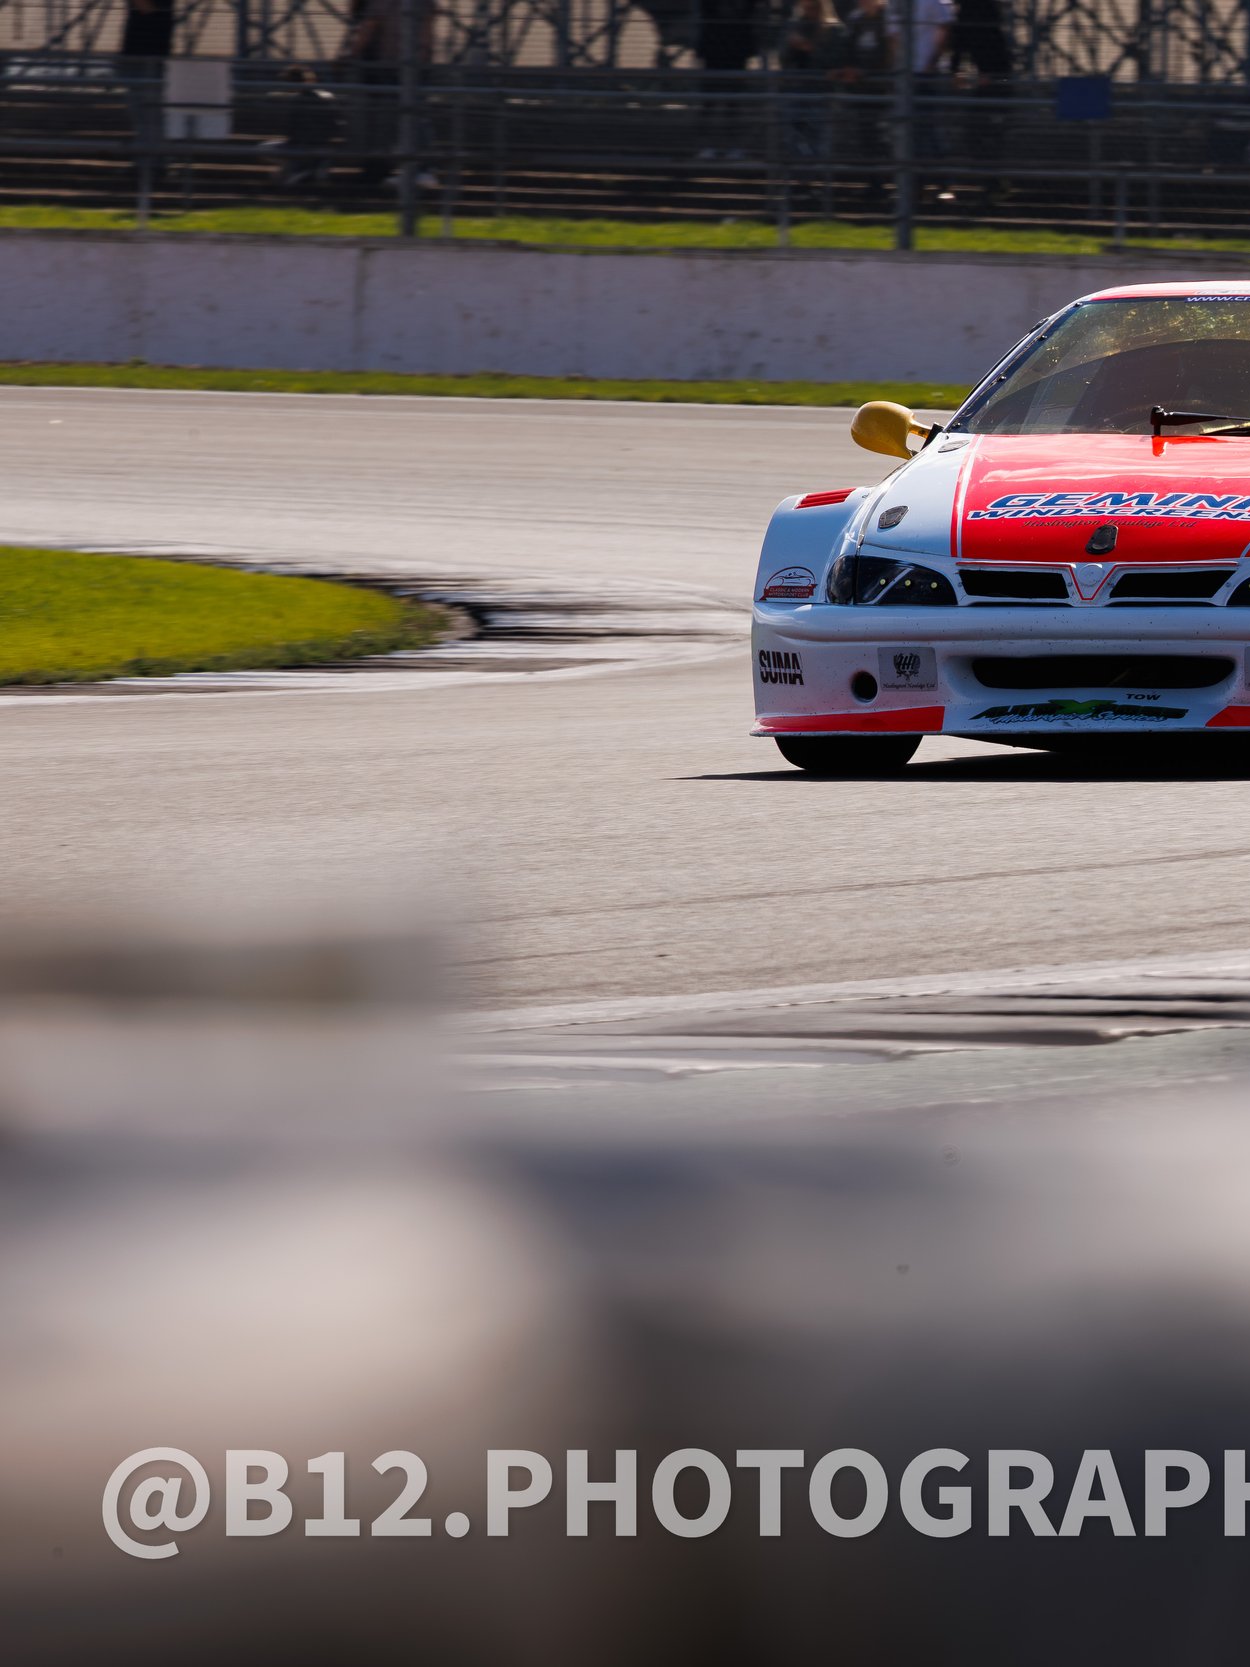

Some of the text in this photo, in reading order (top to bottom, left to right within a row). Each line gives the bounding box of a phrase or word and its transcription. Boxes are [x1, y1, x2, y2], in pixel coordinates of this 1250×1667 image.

[1023, 518, 1100, 528] Haslington
[1168, 519, 1198, 528] Ltd
[758, 649, 805, 685] SUMA
[1125, 693, 1162, 701] TOW
